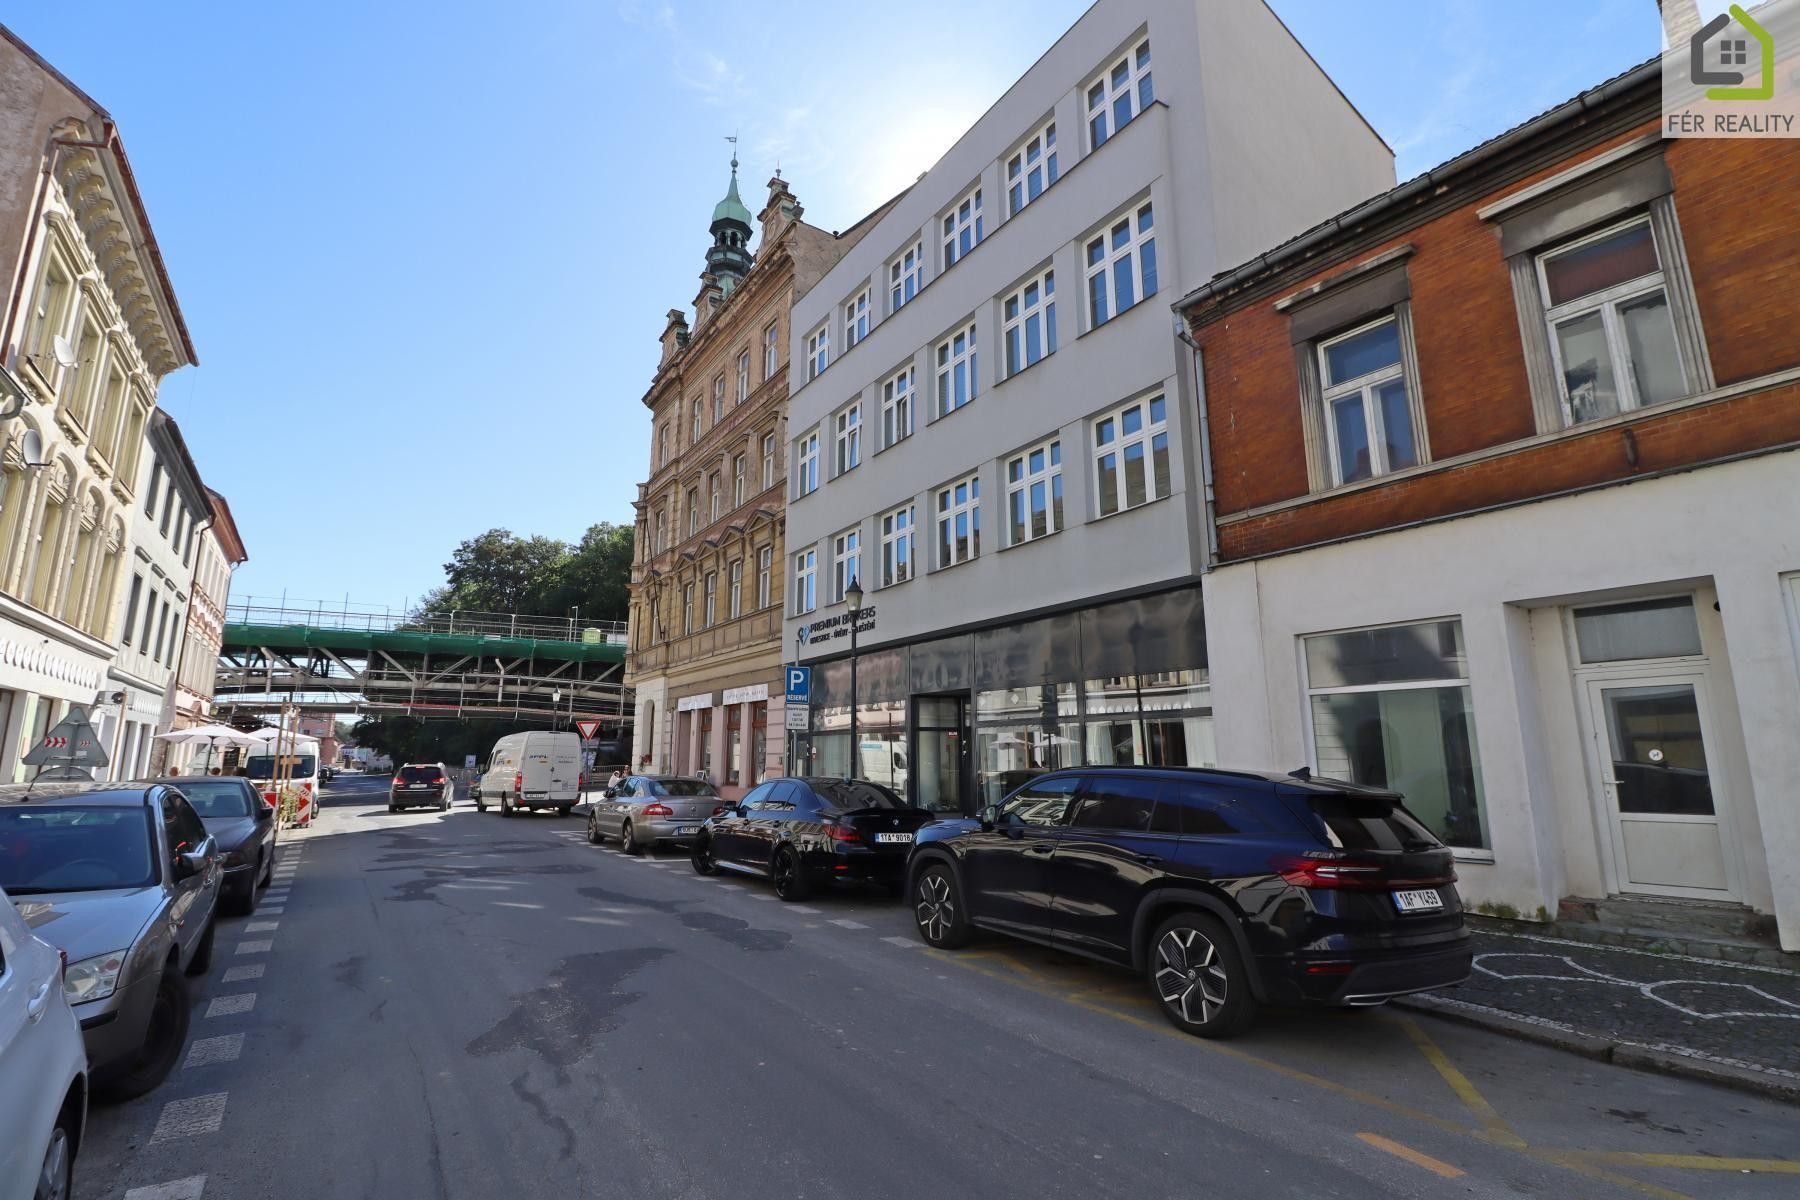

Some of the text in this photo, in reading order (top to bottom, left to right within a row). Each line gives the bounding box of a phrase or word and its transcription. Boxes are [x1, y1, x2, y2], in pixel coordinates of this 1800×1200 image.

[810, 606, 876, 633] PREMIUM BRKERS
[791, 670, 804, 691] P
